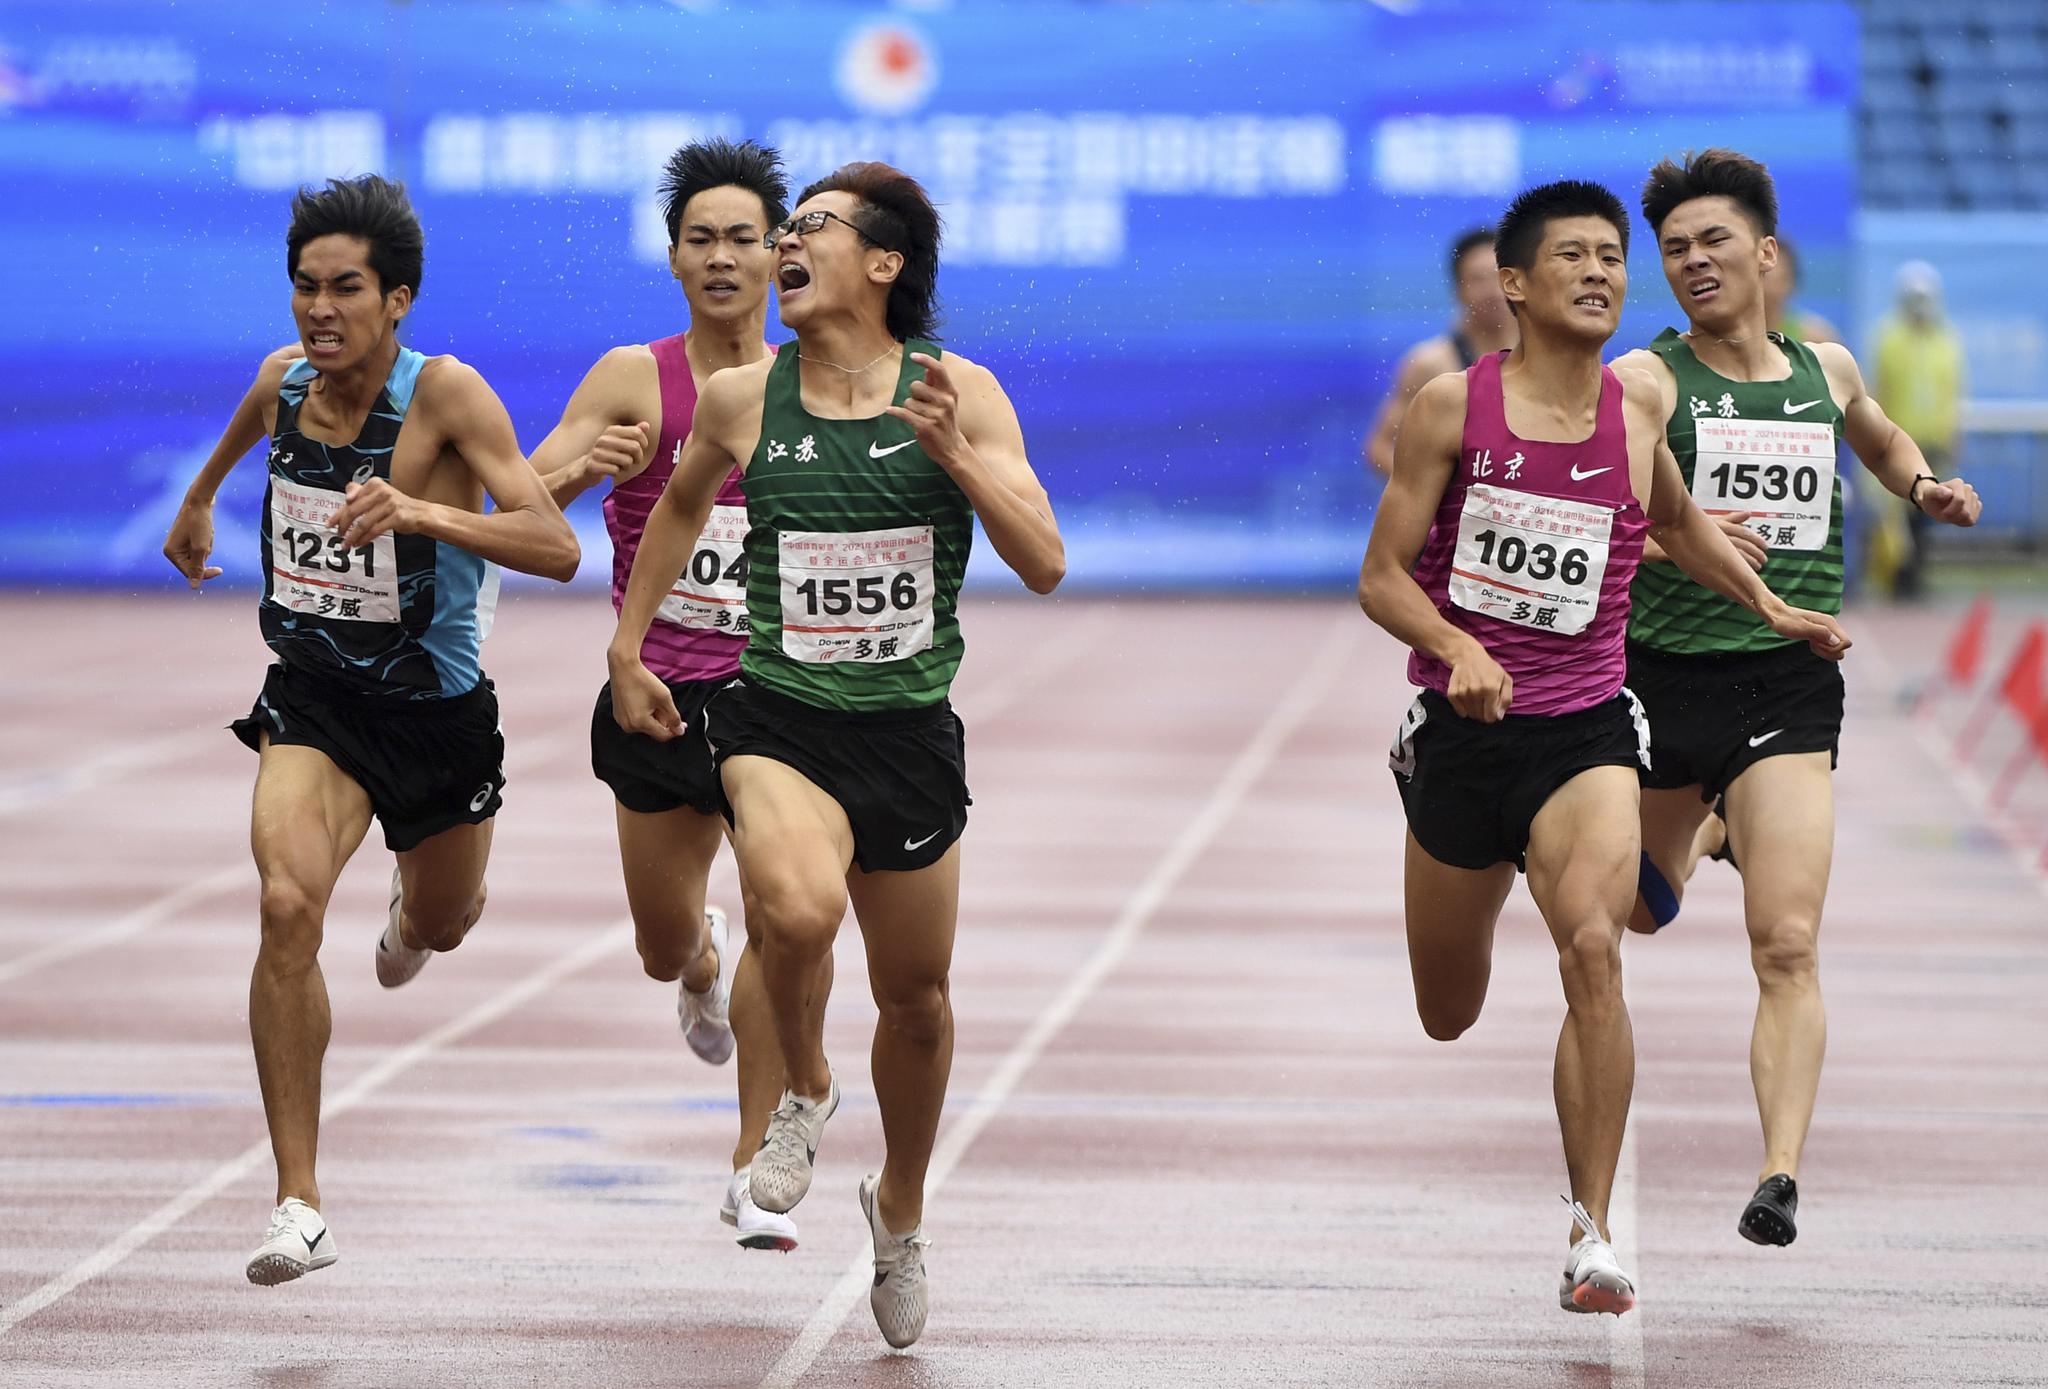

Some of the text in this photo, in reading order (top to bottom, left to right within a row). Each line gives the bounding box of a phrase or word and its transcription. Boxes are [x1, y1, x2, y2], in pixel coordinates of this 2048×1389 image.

[1689, 392, 1740, 418] 江苏
[767, 434, 819, 463] 江苏
[1472, 449, 1525, 481] 北京
[1710, 463, 1818, 503] 1530
[282, 527, 375, 578] 1231
[1475, 529, 1590, 586] 1036
[317, 593, 362, 618] 多威
[796, 572, 918, 616] 1556
[1510, 600, 1560, 628] 多威
[854, 636, 899, 660] 多威
